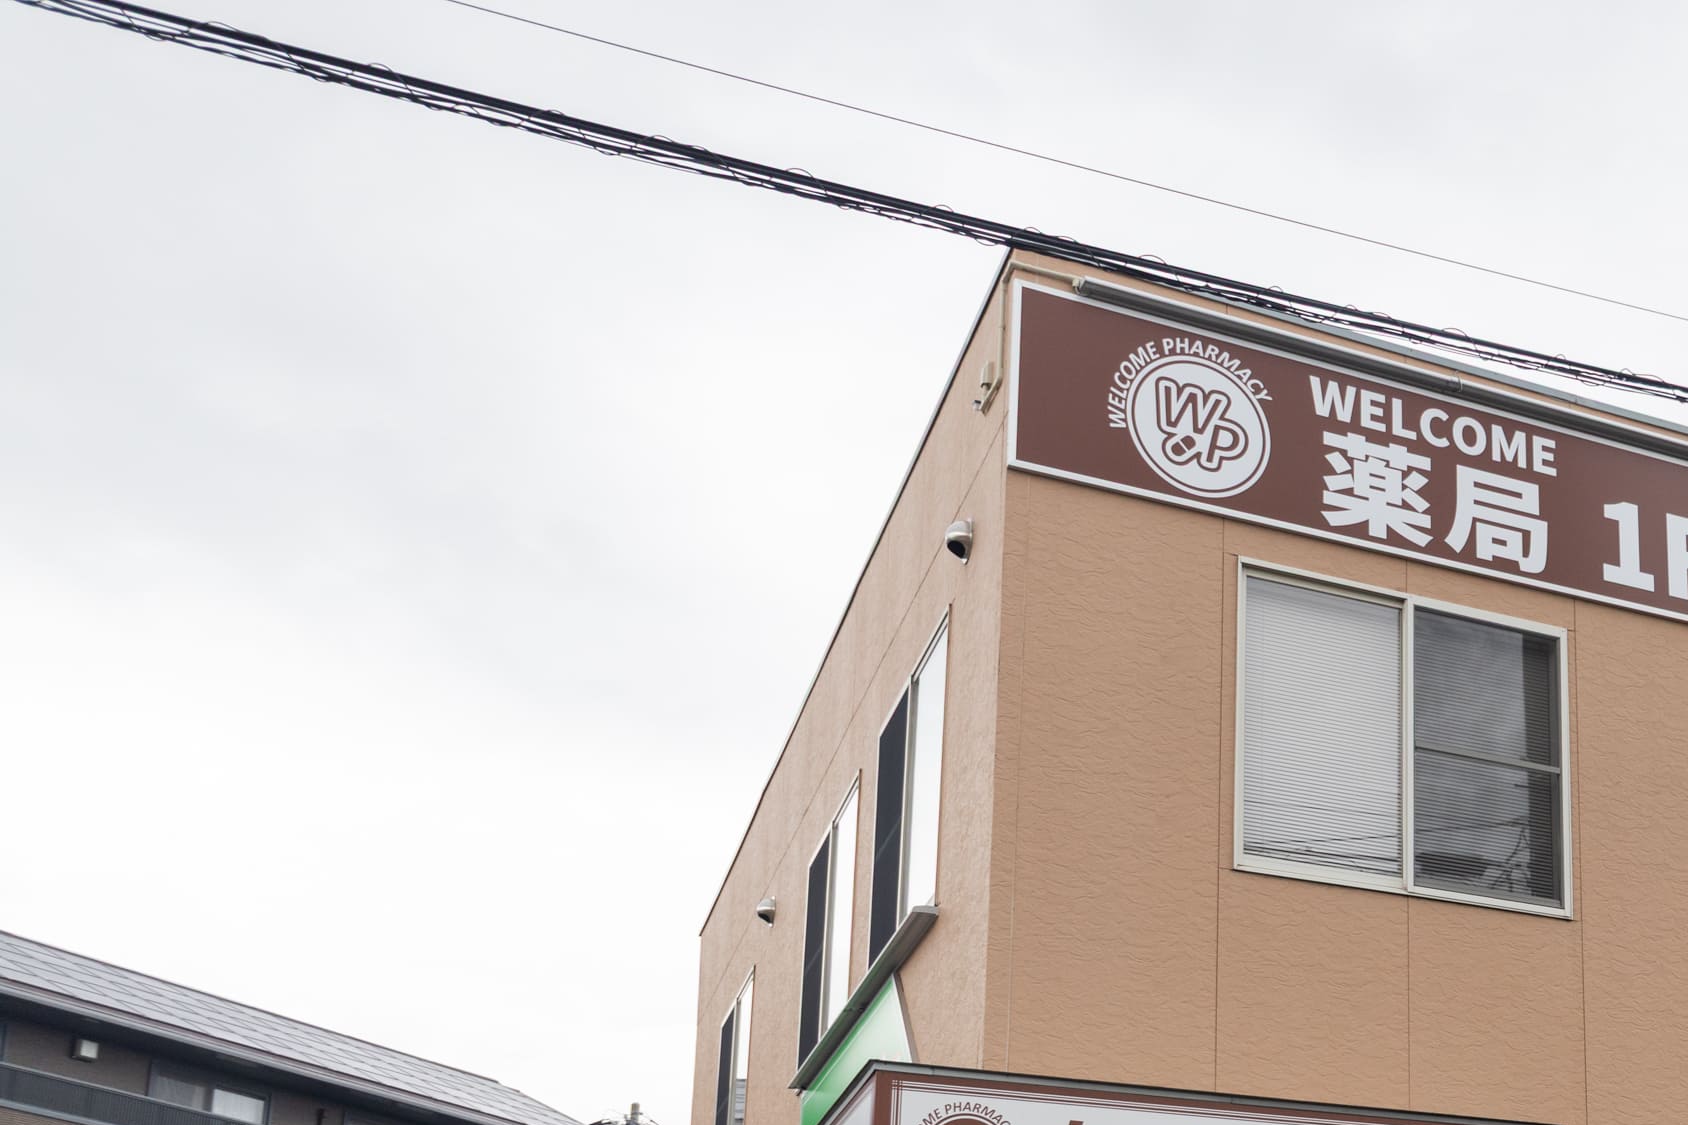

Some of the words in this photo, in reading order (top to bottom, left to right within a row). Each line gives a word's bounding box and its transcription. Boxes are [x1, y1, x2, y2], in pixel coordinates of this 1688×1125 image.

[1108, 340, 1161, 430] WELCOME
[1161, 336, 1273, 403] PHARMACY
[1309, 375, 1557, 477] WELCOME
[1320, 432, 1548, 574] 薬局
